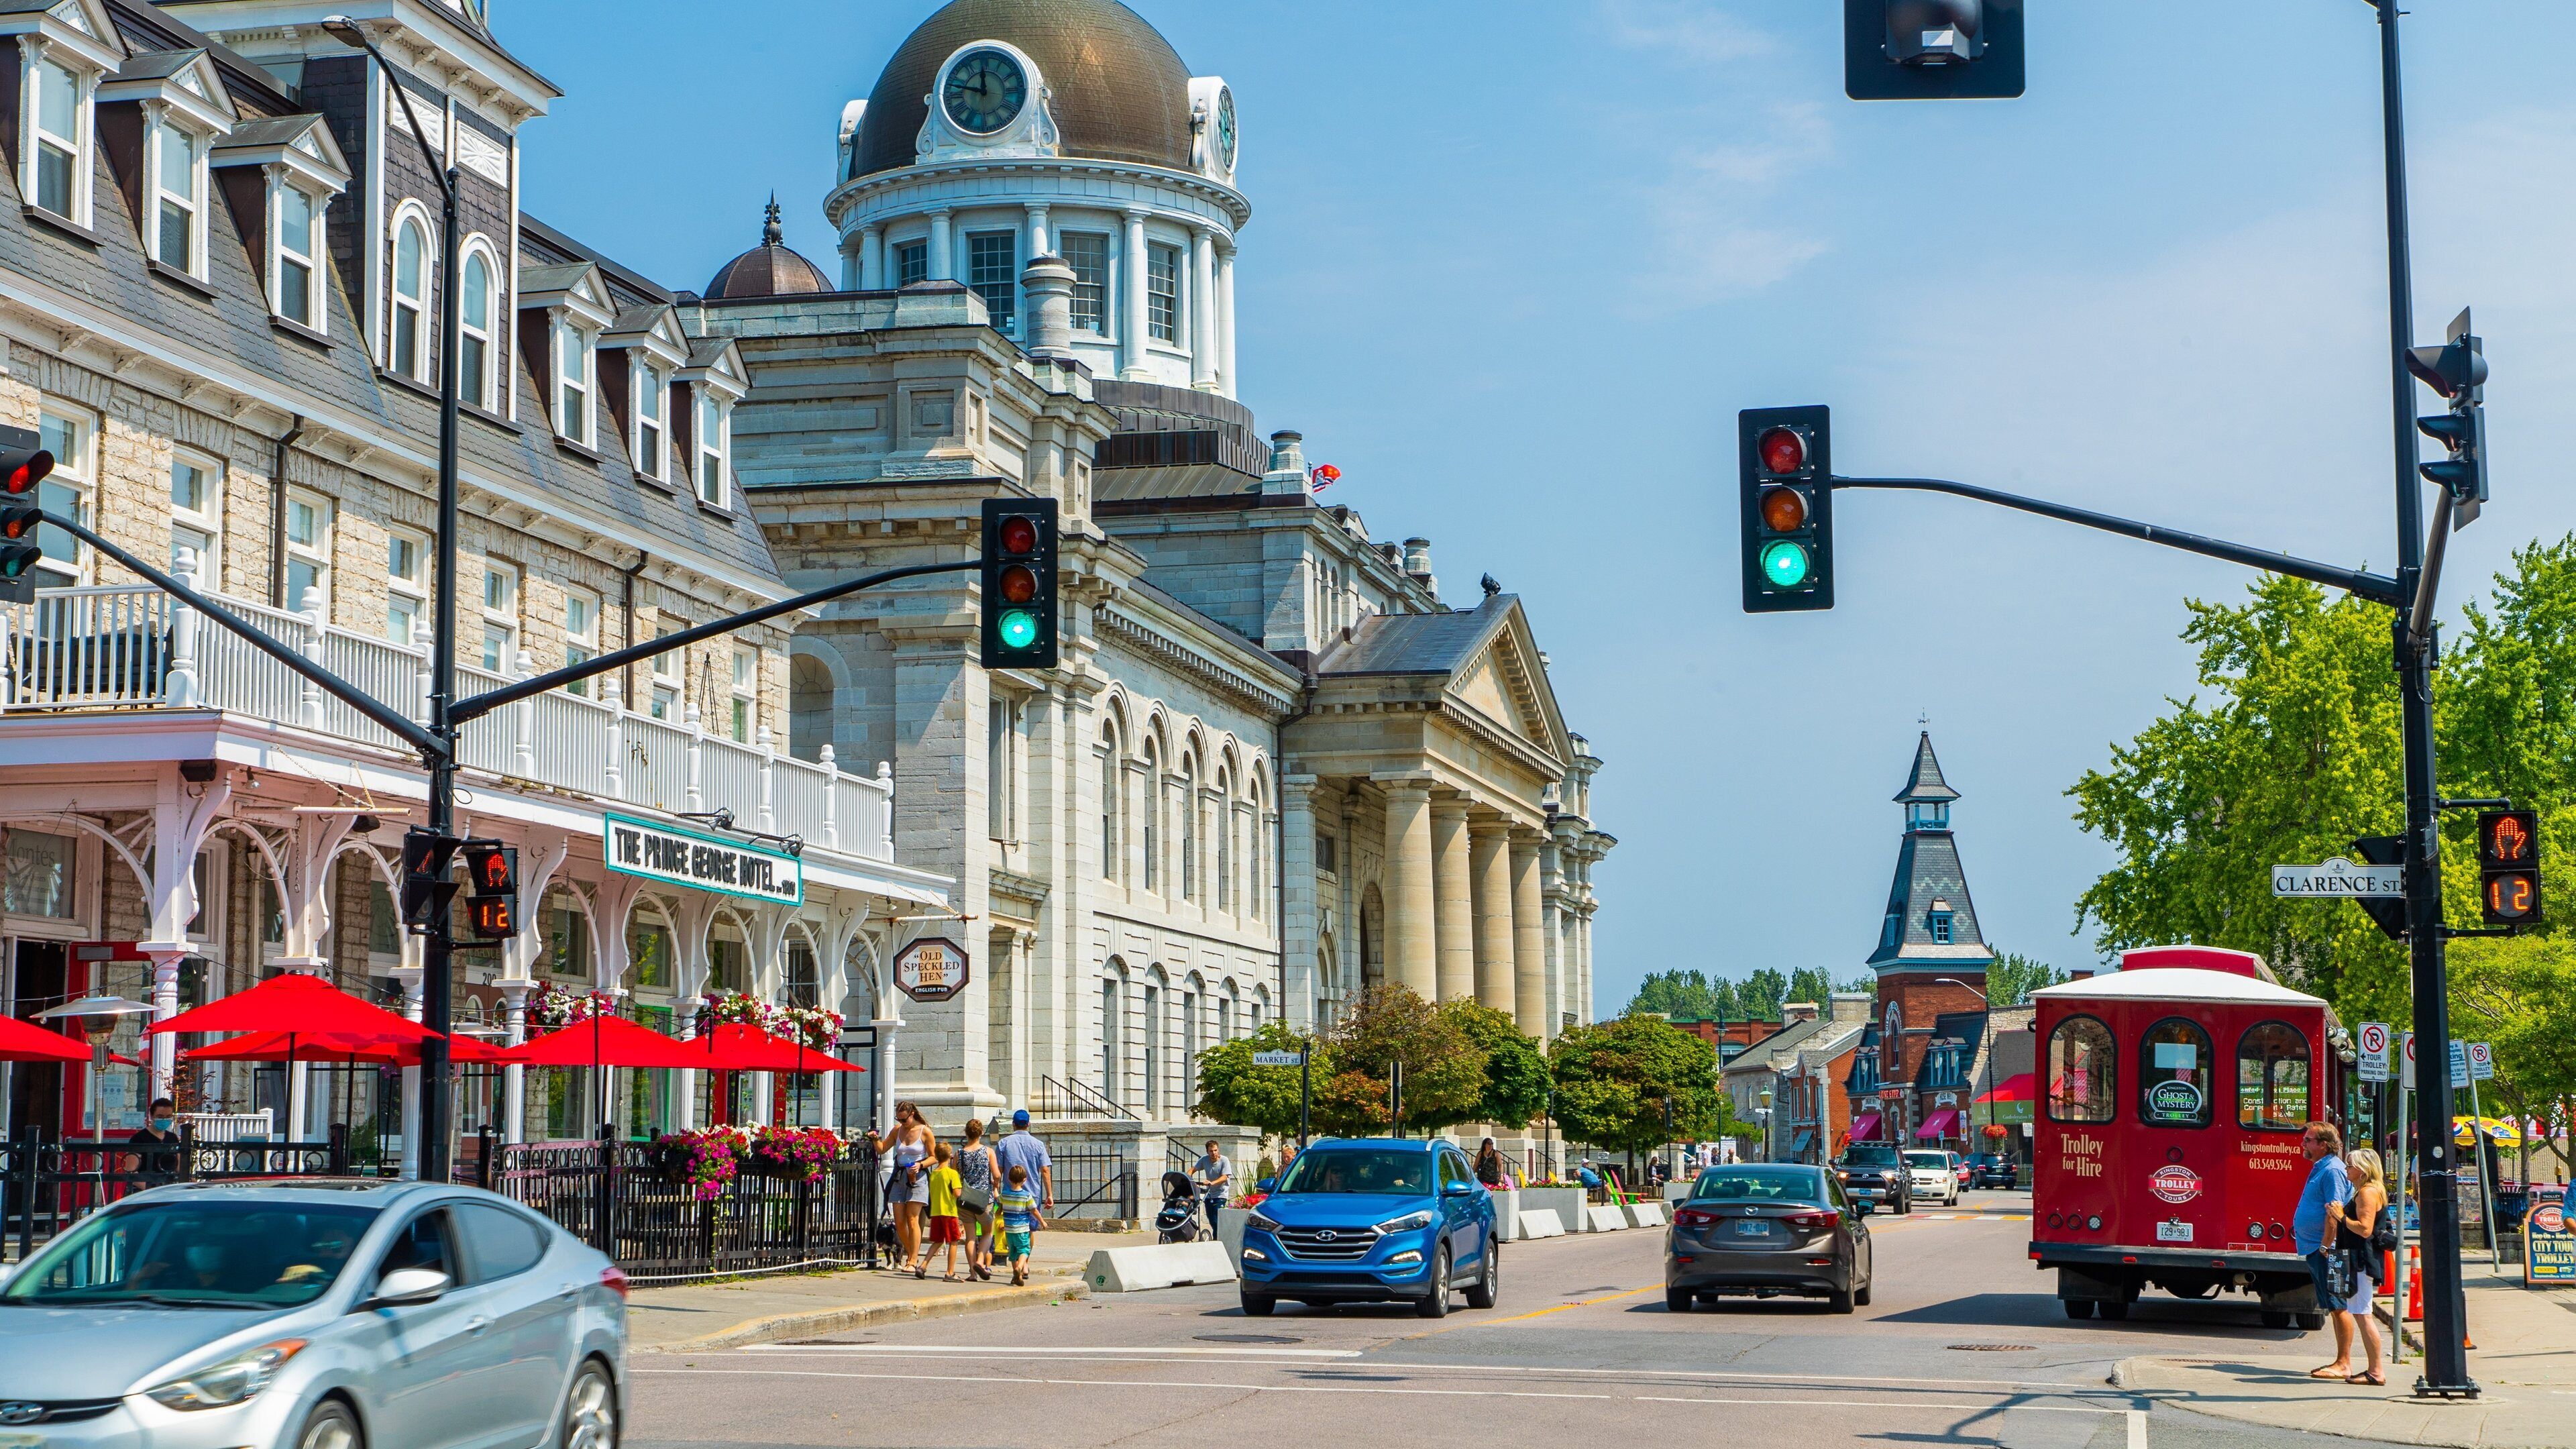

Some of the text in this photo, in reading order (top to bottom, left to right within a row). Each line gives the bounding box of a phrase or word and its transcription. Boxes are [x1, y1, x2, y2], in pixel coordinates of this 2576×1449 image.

[614, 826, 641, 865] THE
[644, 833, 689, 875] PRINCE
[692, 845, 737, 884] GEORGE
[739, 854, 775, 893] HOTEL
[2276, 876, 2401, 892] CLARENCE ST.
[2491, 880, 2529, 910] 12
[483, 904, 508, 928] 12
[466, 947, 500, 959] NTRANCE
[904, 961, 960, 972] SPECKLED
[2362, 1061, 2387, 1069] TROLLEY
[2157, 1089, 2189, 1099] GHOST
[2157, 1100, 2196, 1109] MYSTERY
[2061, 1133, 2104, 1159] Trolley
[2241, 1140, 2301, 1156] kingstontrolley.ca
[2063, 1156, 2102, 1177] for Hire
[2249, 1157, 2292, 1171] 613.549.5544
[2159, 1167, 2191, 1177] KINGSTON
[2154, 1179, 2196, 1189] TROLLEY
[2532, 1240, 2551, 1252] CITY
